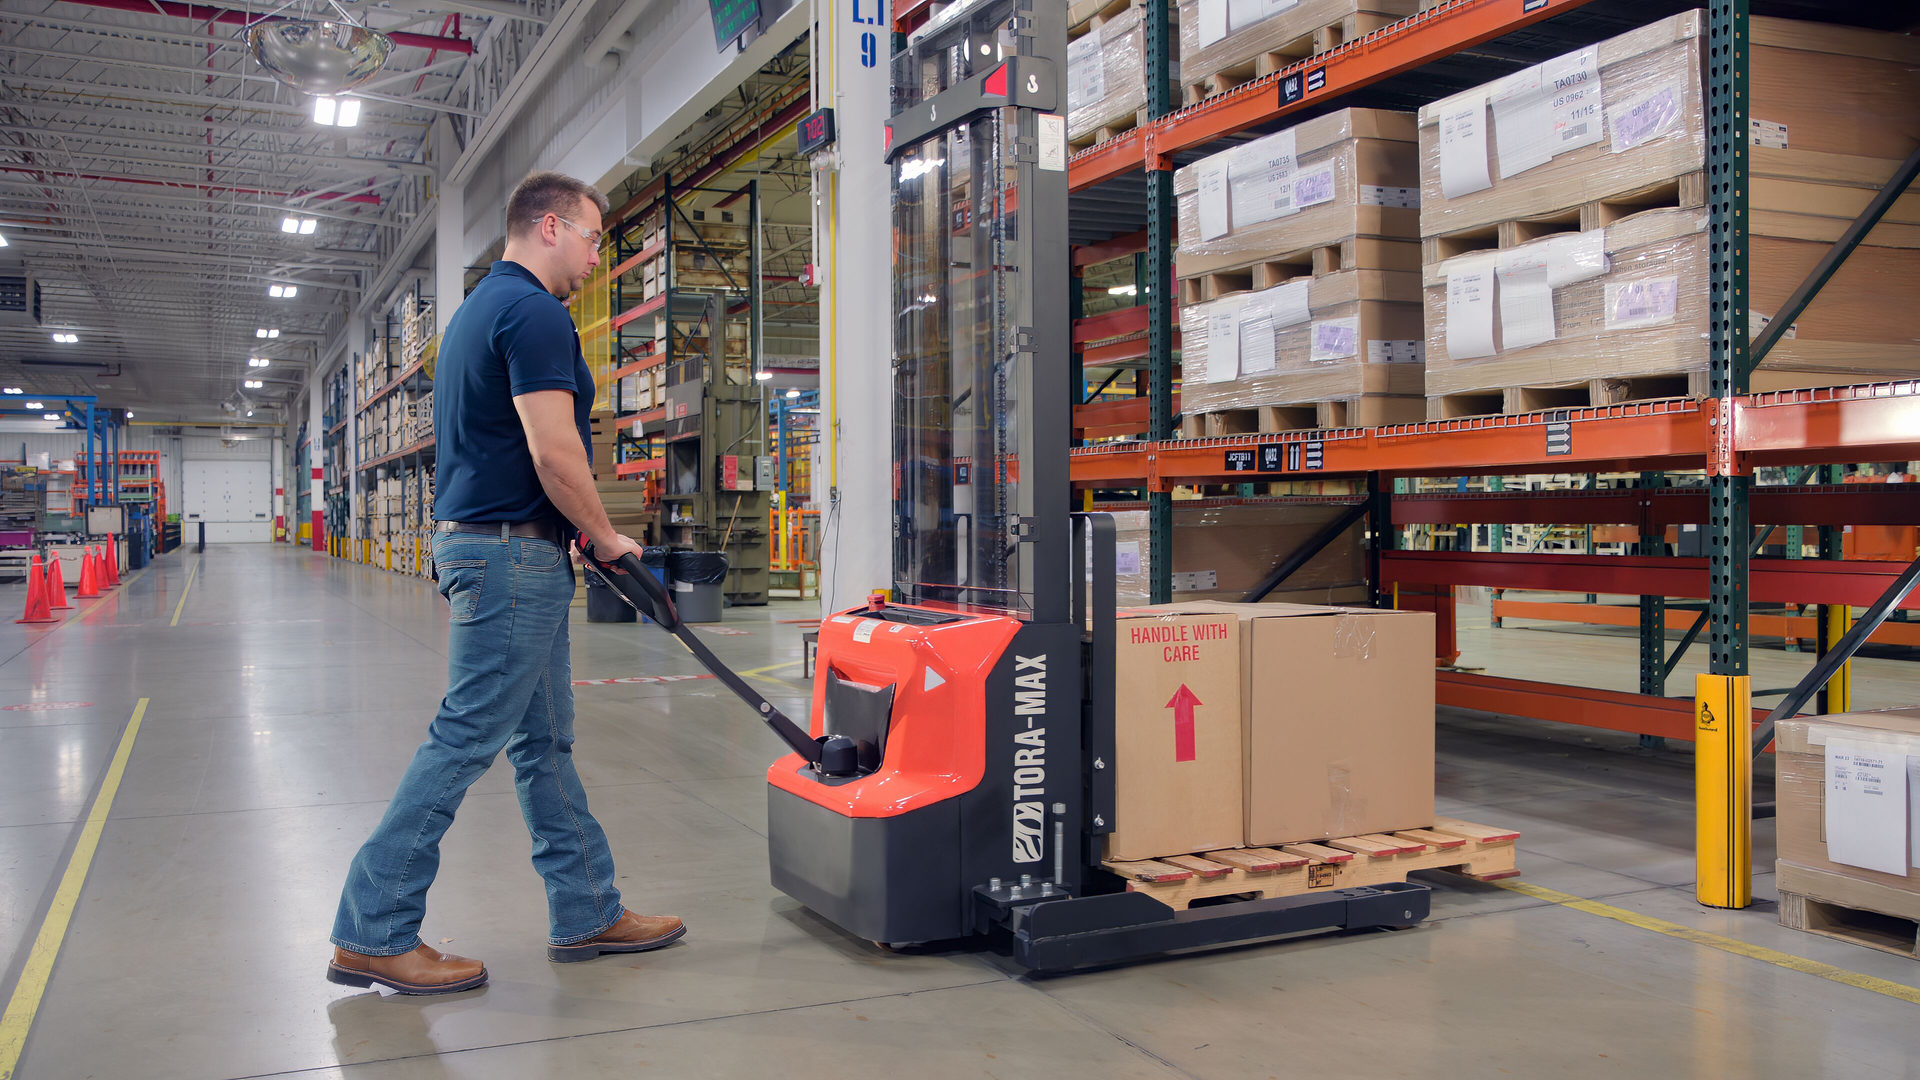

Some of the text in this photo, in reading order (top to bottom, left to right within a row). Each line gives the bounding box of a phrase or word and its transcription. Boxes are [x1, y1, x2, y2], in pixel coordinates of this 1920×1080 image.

[861, 32, 876, 68] 9
[1554, 71, 1588, 90] TA0730
[1553, 98, 1564, 108] US
[1268, 155, 1290, 168] TA0735
[1130, 623, 1228, 644] HANDLE WITH
[1163, 645, 1200, 663] CARE
[1013, 653, 1047, 801] TORA-MAX
